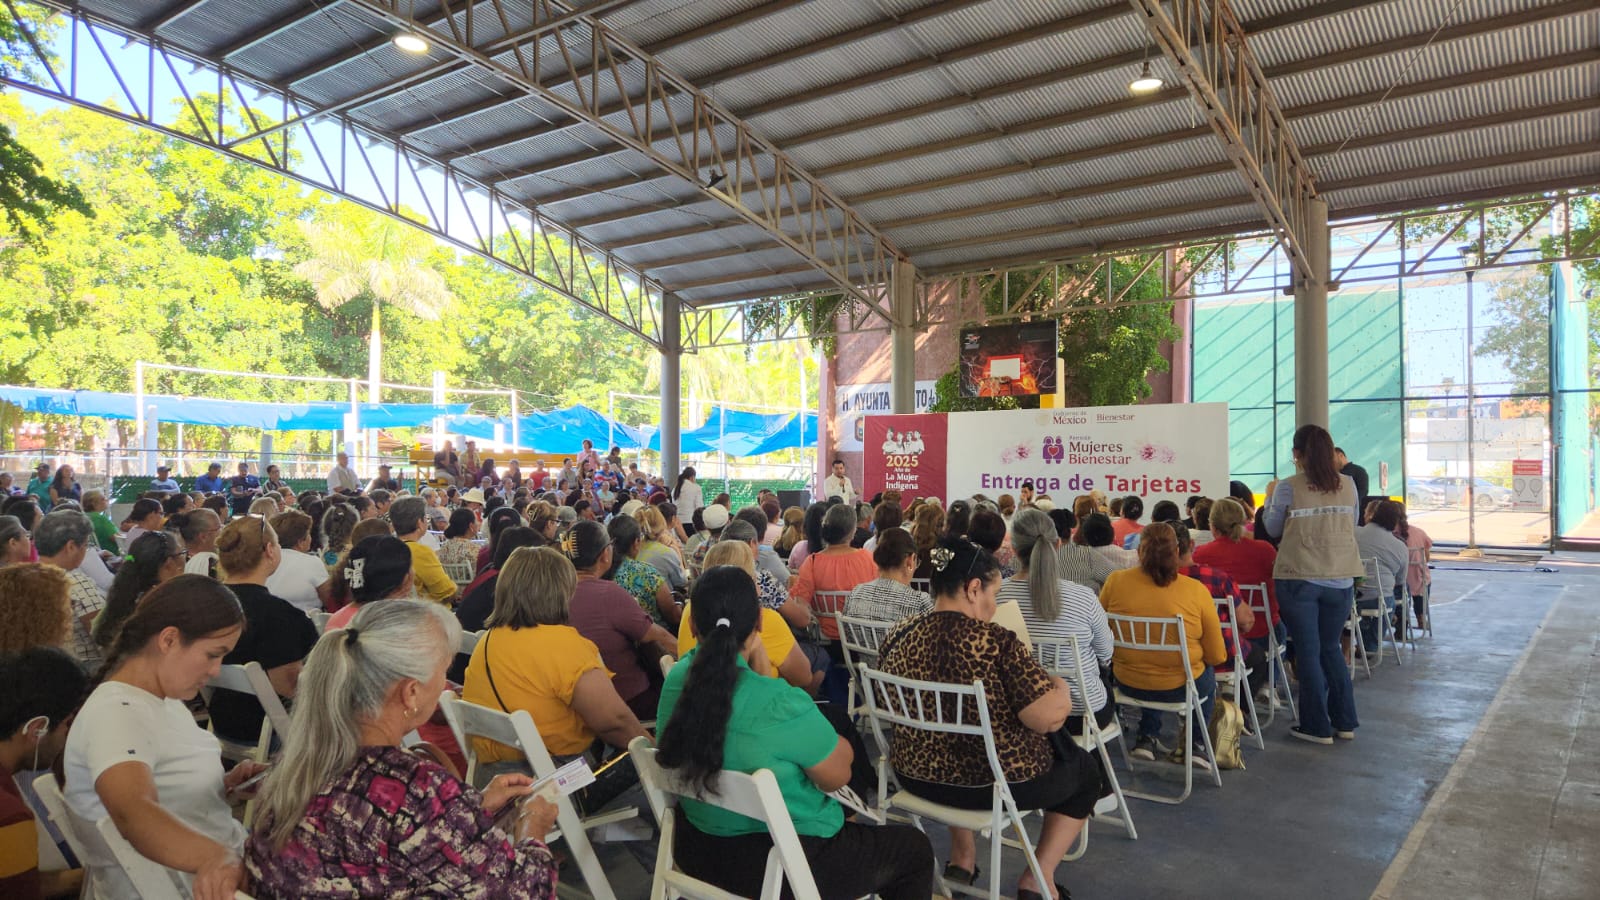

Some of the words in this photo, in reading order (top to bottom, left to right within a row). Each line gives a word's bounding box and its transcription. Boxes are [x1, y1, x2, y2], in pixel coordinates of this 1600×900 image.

[1096, 413, 1135, 421] Bienestar
[1069, 441, 1123, 455] Mujeres
[886, 455, 919, 468] 2025
[1069, 453, 1132, 464] Bienestar
[885, 472, 895, 480] La
[896, 472, 919, 482] Mujer
[1068, 473, 1094, 491] de
[1105, 475, 1201, 497] Tarjetas
